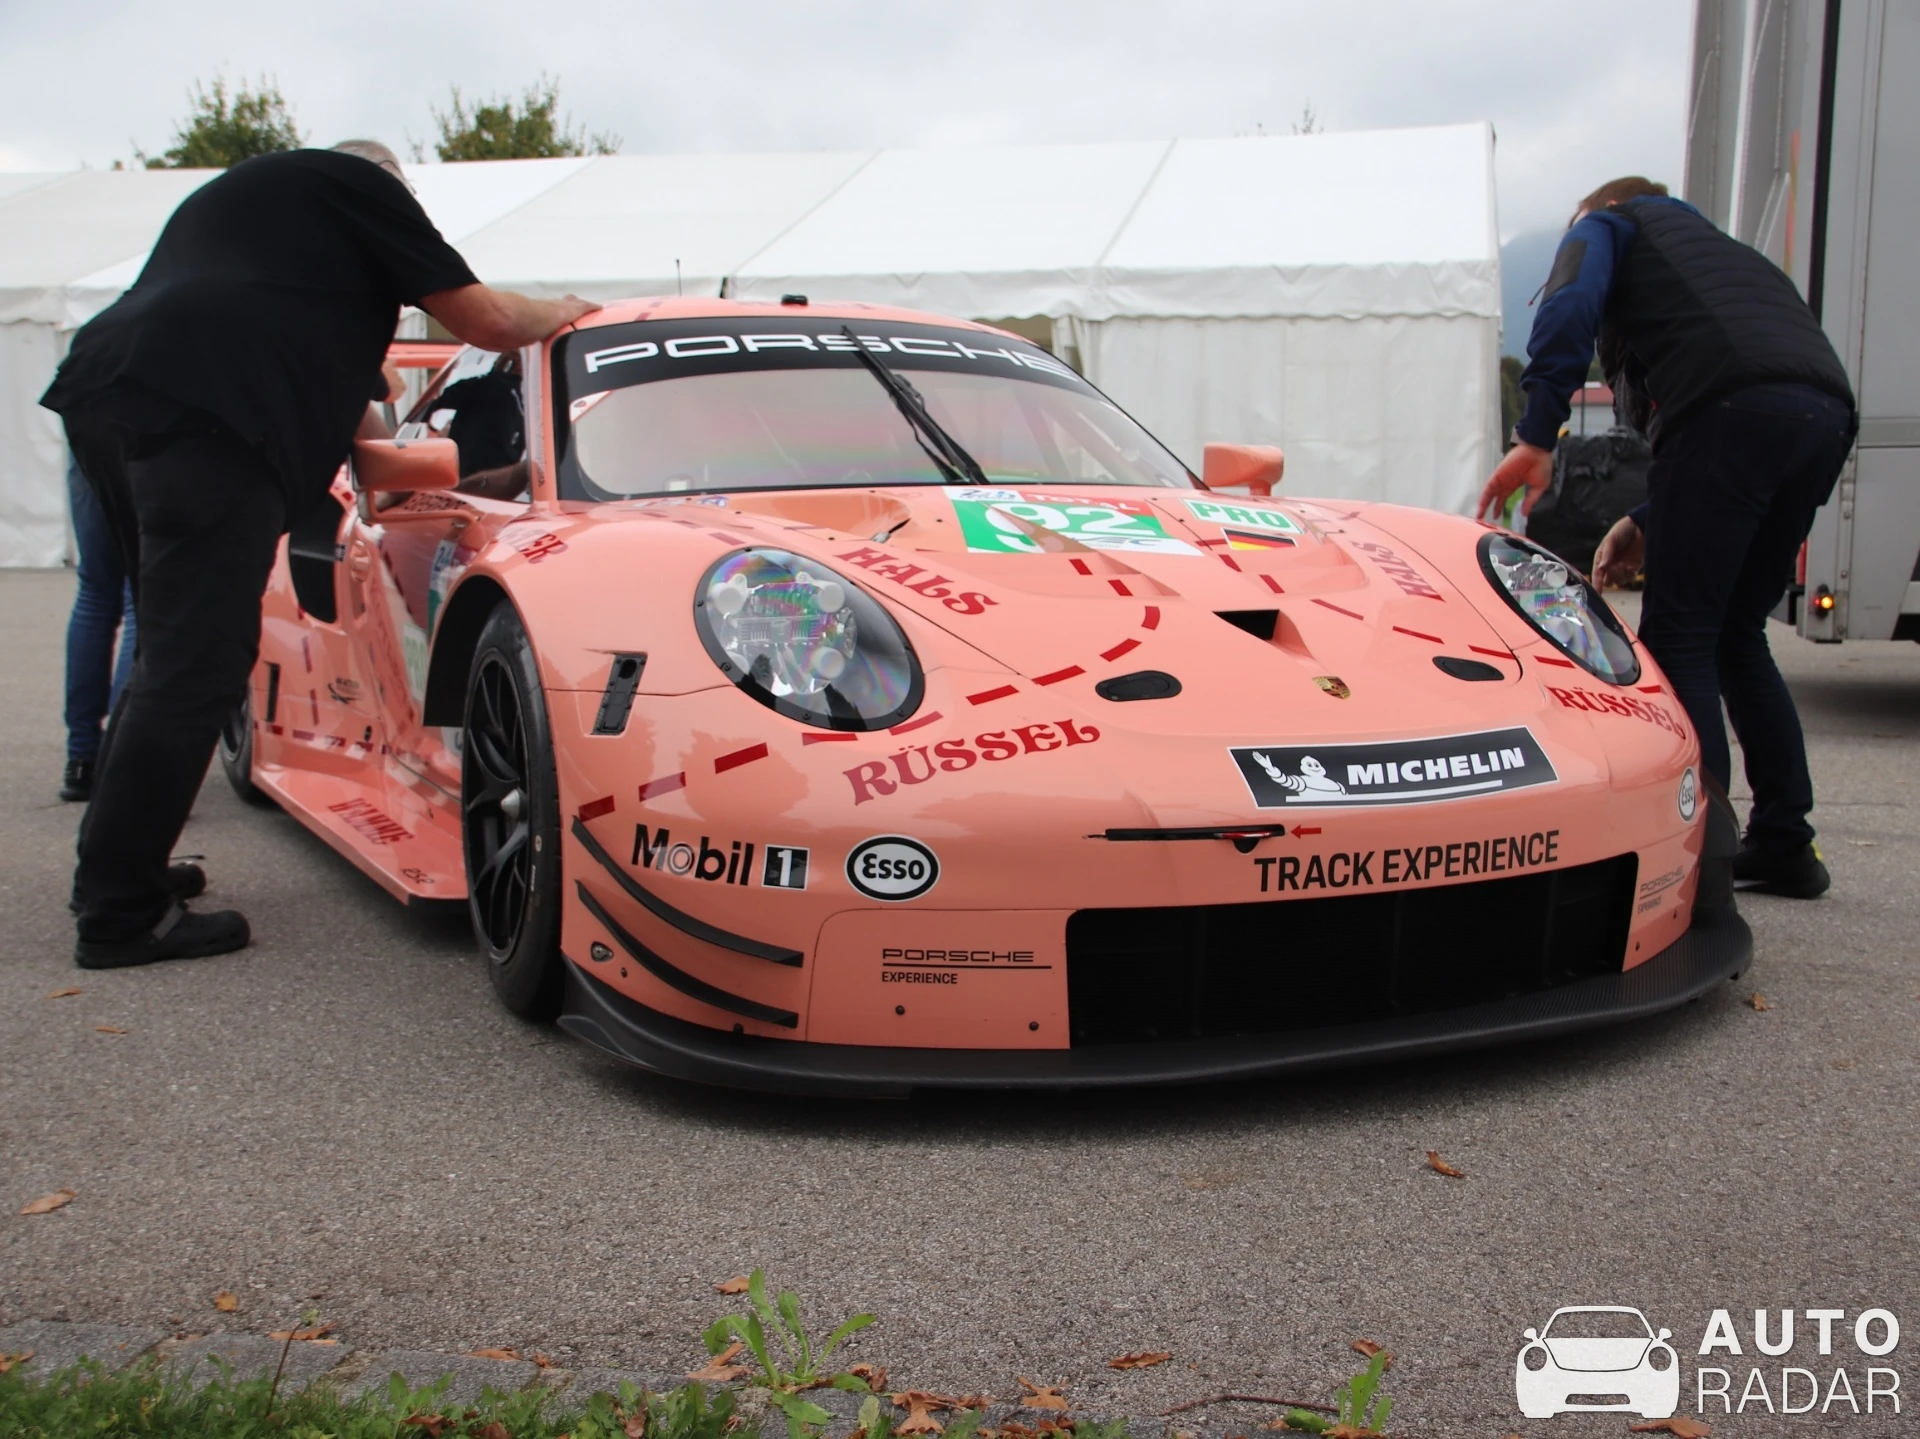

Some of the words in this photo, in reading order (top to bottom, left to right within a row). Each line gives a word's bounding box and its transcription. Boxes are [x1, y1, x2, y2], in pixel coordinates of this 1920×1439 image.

[584, 334, 1080, 381] PORSCHE
[1191, 502, 1291, 529] PRO
[833, 546, 999, 615] HALS
[1545, 685, 1686, 740] RÜSSEL
[843, 718, 1101, 806] RÜSSEL
[1347, 747, 1526, 786] MICHELIN
[631, 824, 755, 887] Mobil
[861, 853, 925, 881] Esso
[1254, 850, 1375, 893] TRACK
[1382, 830, 1560, 884] EXPERIENCE
[881, 971, 959, 985] EXPERIENCE
[882, 948, 1035, 963] PORSCHE
